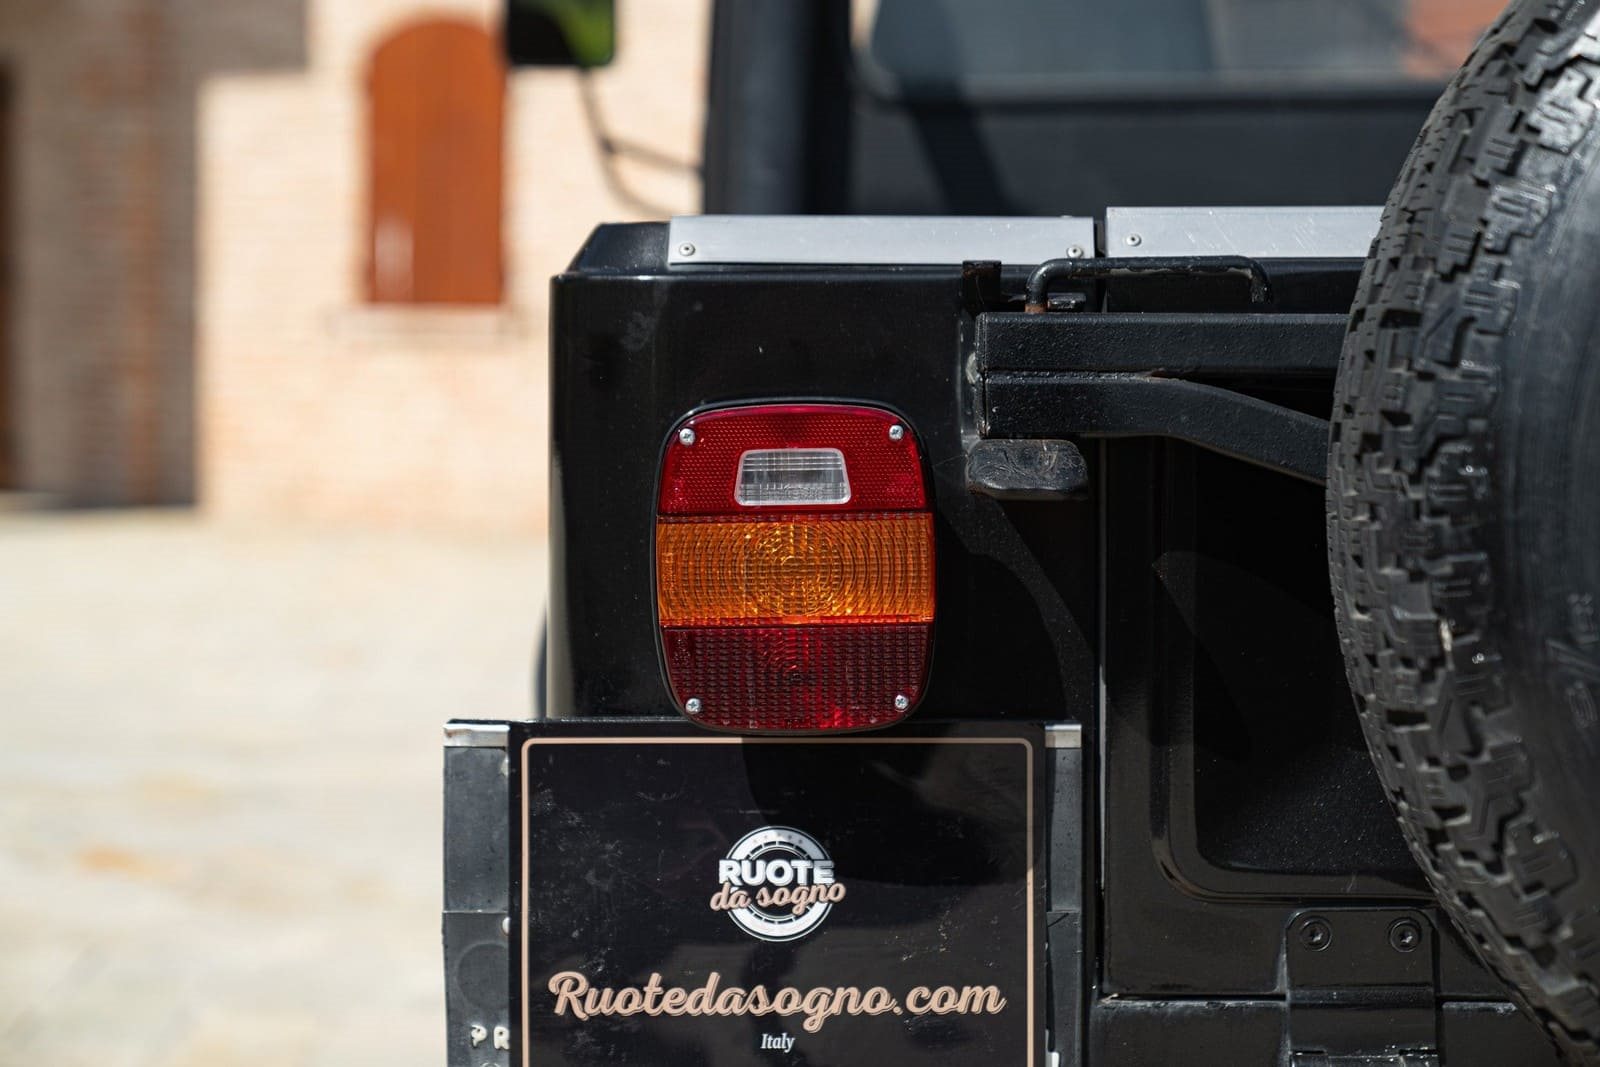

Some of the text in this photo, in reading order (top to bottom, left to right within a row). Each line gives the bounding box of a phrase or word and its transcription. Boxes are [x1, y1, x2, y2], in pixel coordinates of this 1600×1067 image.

[718, 859, 835, 886] RUOTE
[709, 880, 847, 916] da sogno
[548, 970, 1007, 1034] Ruotedasogno.com
[760, 1032, 796, 1053] Italy
